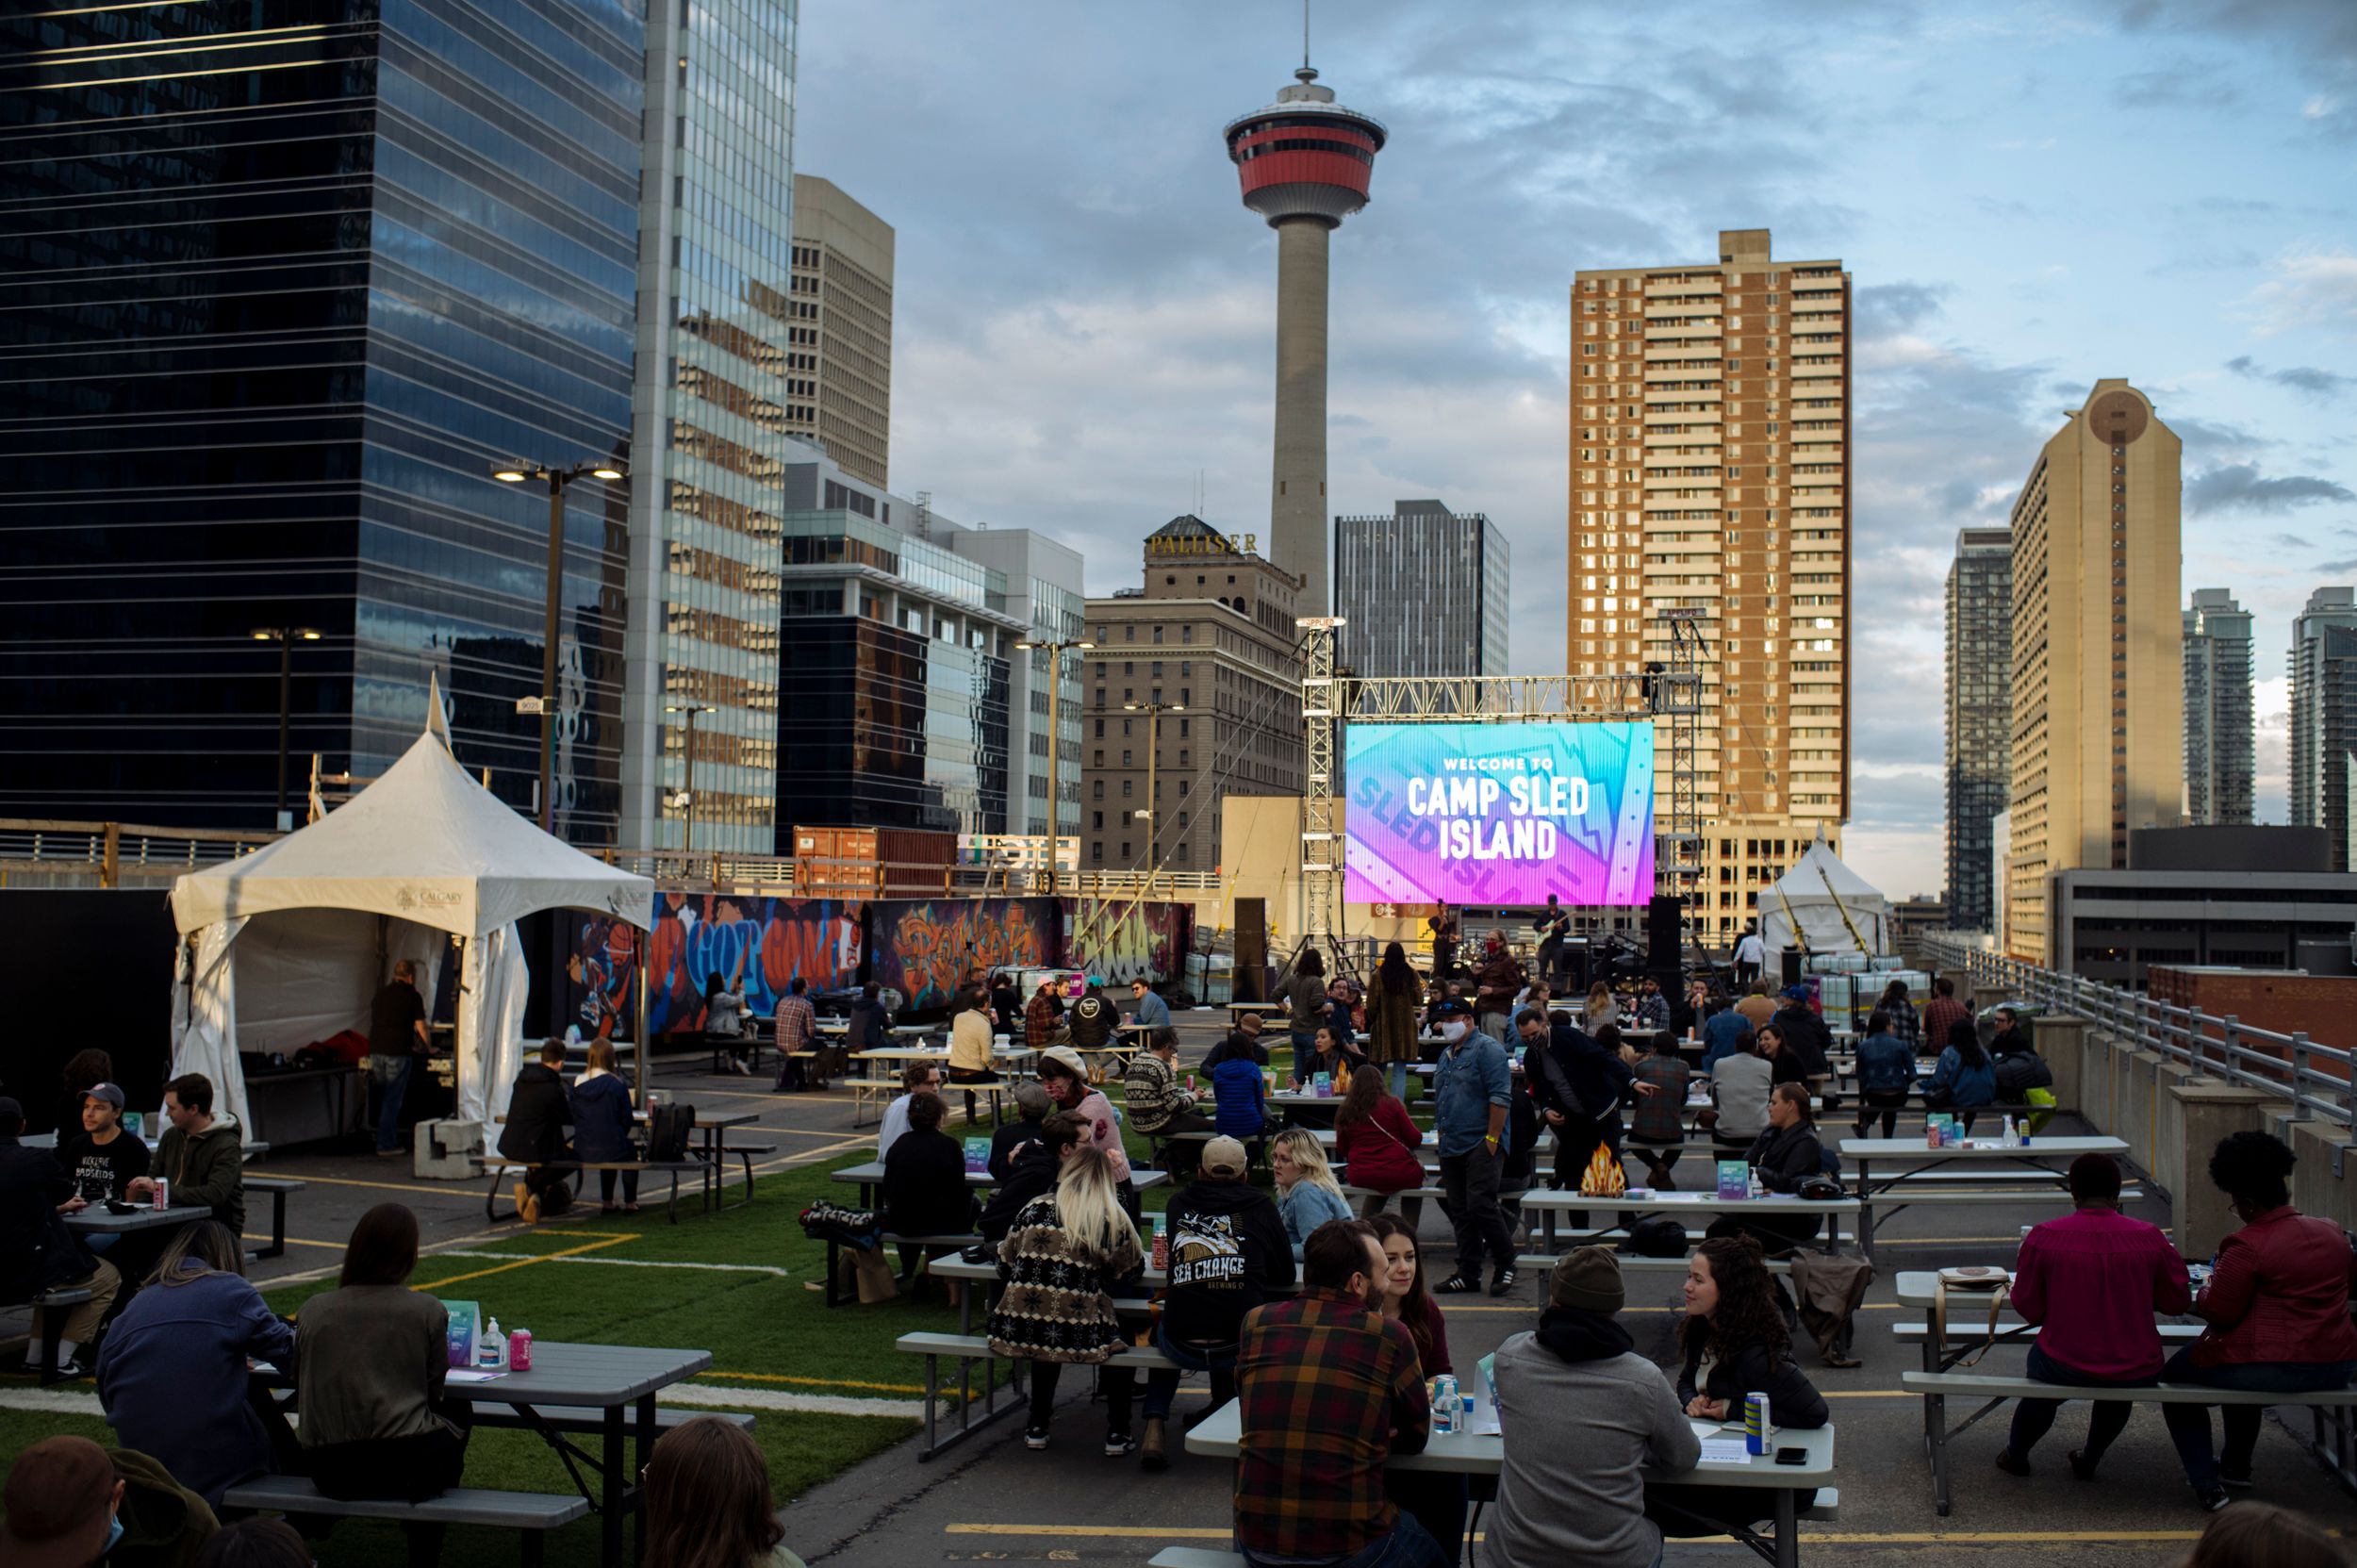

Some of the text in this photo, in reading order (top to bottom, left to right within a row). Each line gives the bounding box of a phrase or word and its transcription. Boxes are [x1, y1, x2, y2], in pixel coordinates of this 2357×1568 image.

[1151, 534, 1258, 554] PALLISER
[1443, 758, 1553, 770] WELCOME TO
[1408, 776, 1589, 817] CAMP SLED
[1440, 818, 1556, 862] ISLAND
[1173, 1257, 1245, 1284] SEA CHANGE
[1208, 1282, 1237, 1291] BREWING
